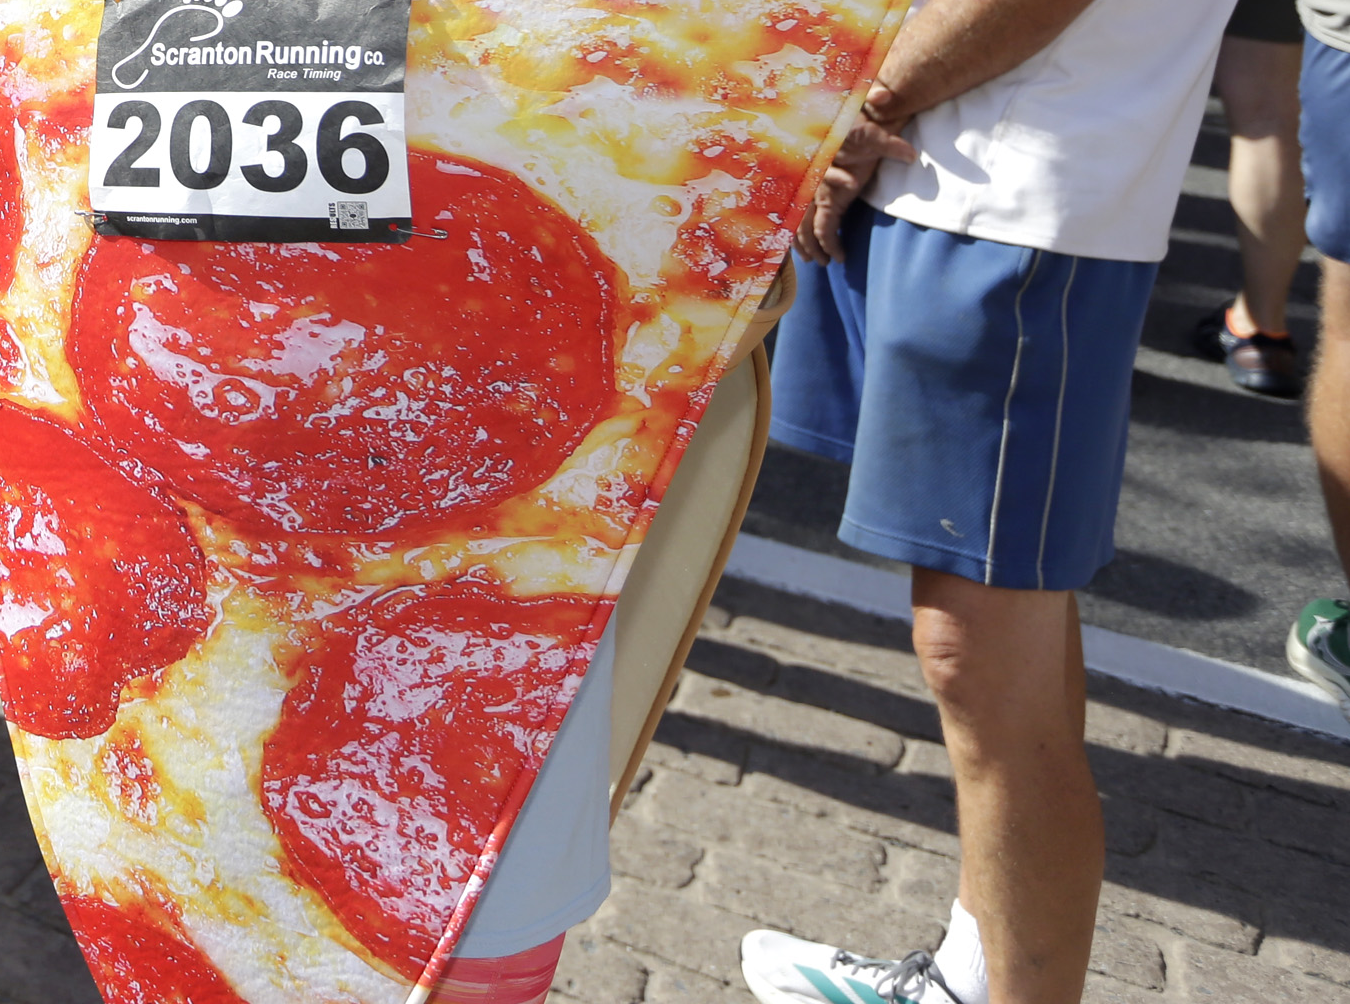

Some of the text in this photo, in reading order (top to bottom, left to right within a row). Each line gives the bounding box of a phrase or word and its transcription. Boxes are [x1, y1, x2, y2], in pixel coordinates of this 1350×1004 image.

[150, 42, 252, 67] Scranton
[255, 40, 361, 70] Running
[267, 67, 342, 81] Race Timing
[102, 99, 390, 194] 2036
[126, 215, 198, 225] scrantonrunning.com
